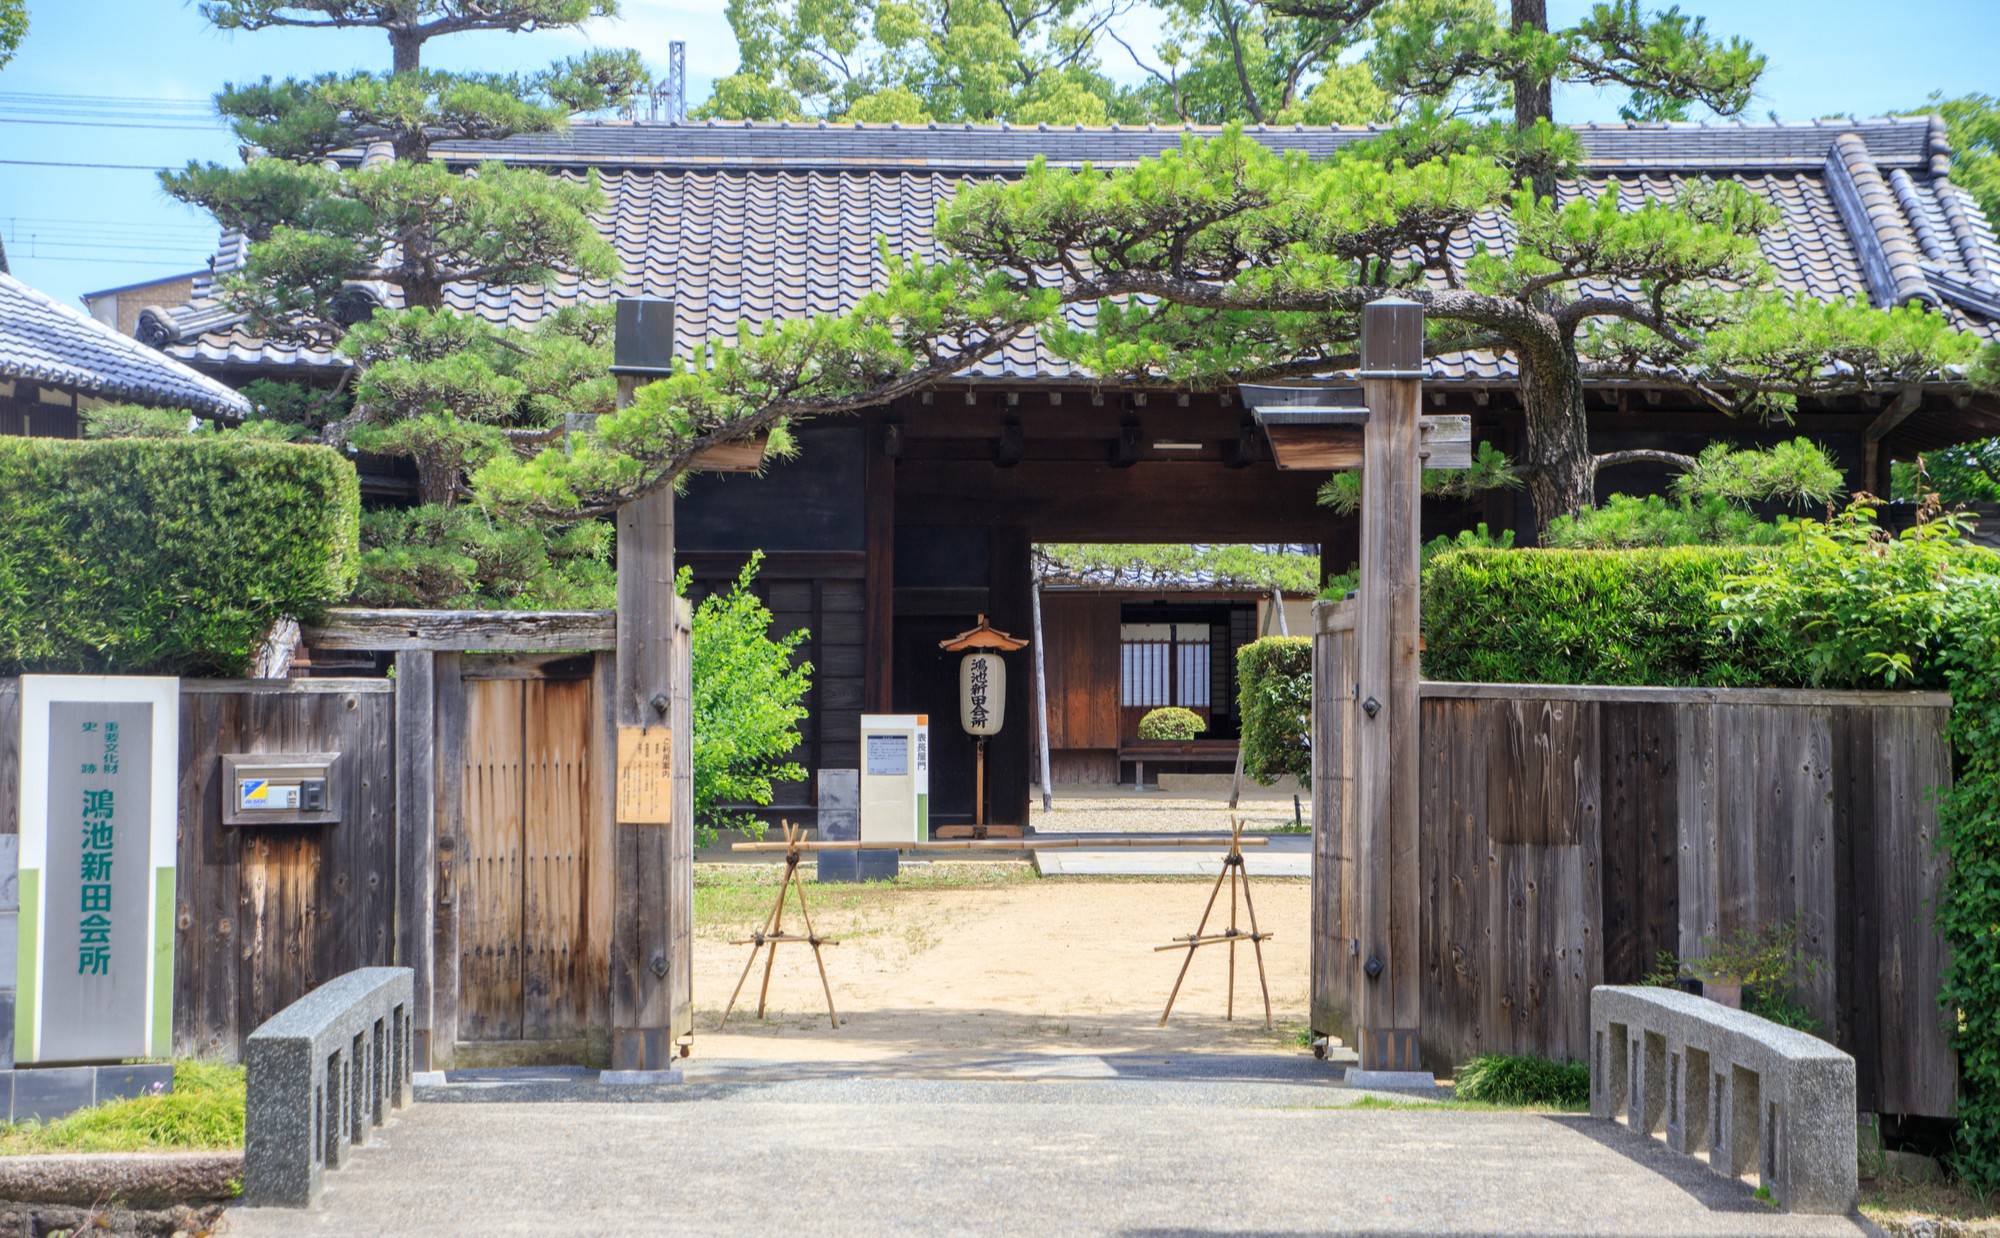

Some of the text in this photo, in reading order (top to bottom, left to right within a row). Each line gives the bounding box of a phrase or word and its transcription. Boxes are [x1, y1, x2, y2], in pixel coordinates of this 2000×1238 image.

[970, 658, 988, 728] 鴻池新田会所
[104, 722, 119, 774] 重要文化財
[663, 738, 671, 777] ご利用案内
[917, 733, 926, 770] 表長屋門
[78, 788, 114, 976] 鴻池新田会所
